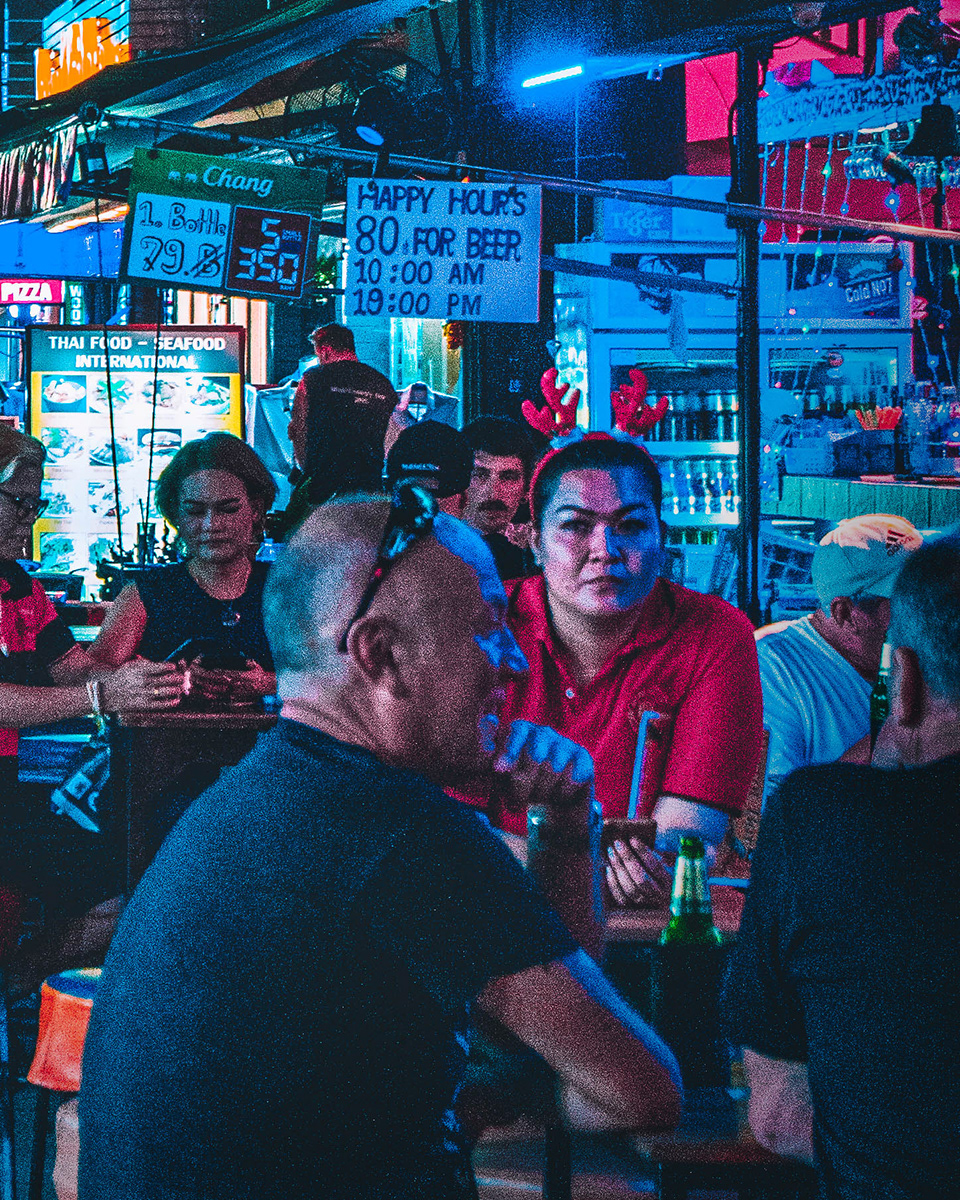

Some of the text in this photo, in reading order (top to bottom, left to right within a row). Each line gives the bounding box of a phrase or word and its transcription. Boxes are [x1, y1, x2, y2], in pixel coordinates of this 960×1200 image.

[202, 165, 274, 197] Chang
[357, 184, 435, 213] HAPPY
[413, 227, 456, 257] FOR
[466, 227, 522, 262] BEER
[448, 262, 485, 285] AM
[1, 281, 52, 301] PIZZA
[446, 293, 482, 316] PM
[48, 336, 85, 349] THAI
[90, 336, 132, 349] FOOD
[153, 337, 226, 350] SEAFOOD
[75, 355, 198, 369] INTERNATIONAL
